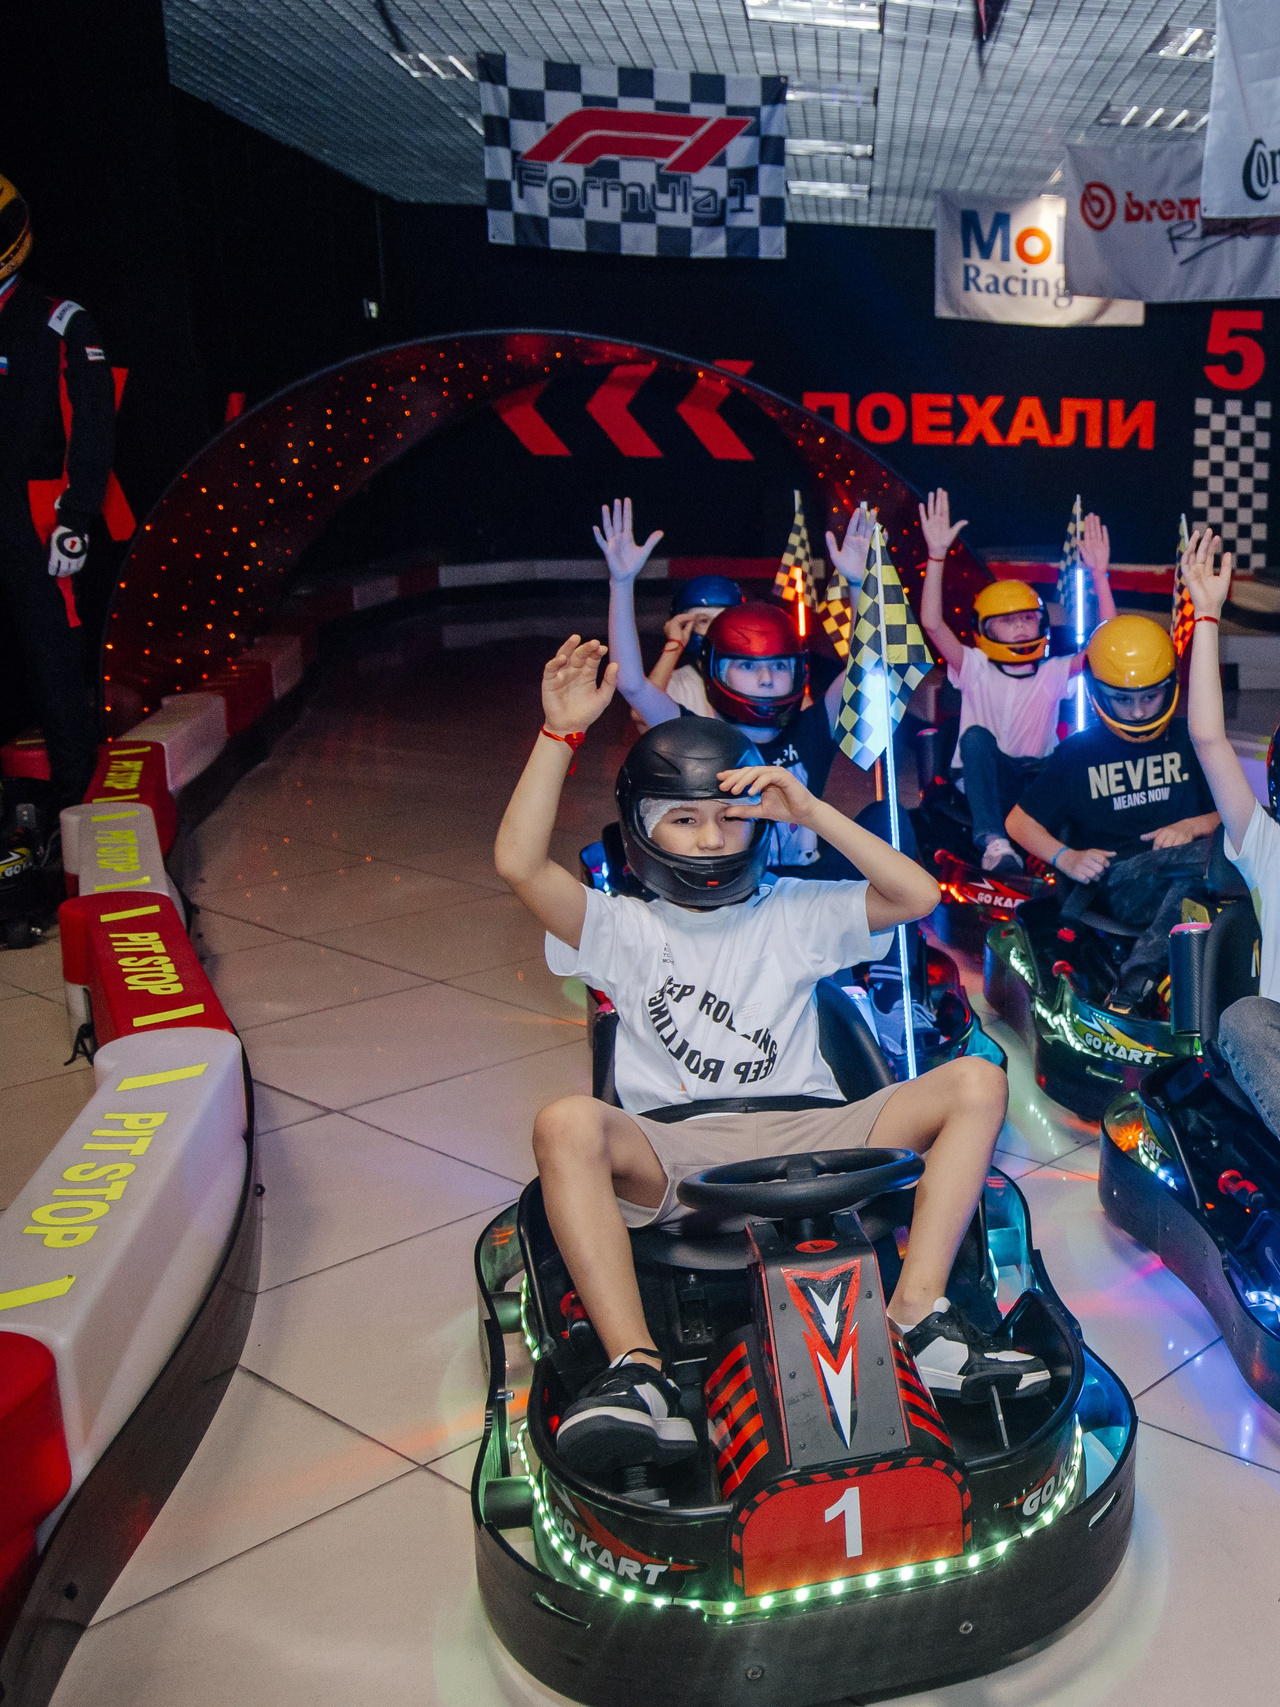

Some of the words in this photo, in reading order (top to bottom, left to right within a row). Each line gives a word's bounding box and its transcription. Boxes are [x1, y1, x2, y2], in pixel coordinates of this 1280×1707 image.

[1124, 191, 1201, 223] brem
[962, 263, 1074, 309] Racing
[1203, 310, 1265, 390] 5
[802, 392, 1155, 450] ПОЕХАЛИ
[1088, 752, 1189, 799] NEVER.
[1113, 791, 1147, 811] MEANS
[1148, 787, 1170, 803] NOW
[977, 892, 992, 904] GO
[994, 896, 1025, 909] KAR
[109, 931, 167, 953] PIT
[117, 954, 184, 996] STOP
[1085, 1033, 1102, 1049] GO
[1103, 1041, 1158, 1064] KART
[82, 1112, 169, 1156] PIT
[1144, 1133, 1163, 1160] ART
[22, 1162, 137, 1249] STOP
[1022, 1476, 1056, 1516] GO
[824, 1486, 863, 1558] 1
[554, 1505, 576, 1541] GO
[579, 1533, 669, 1586] KART
